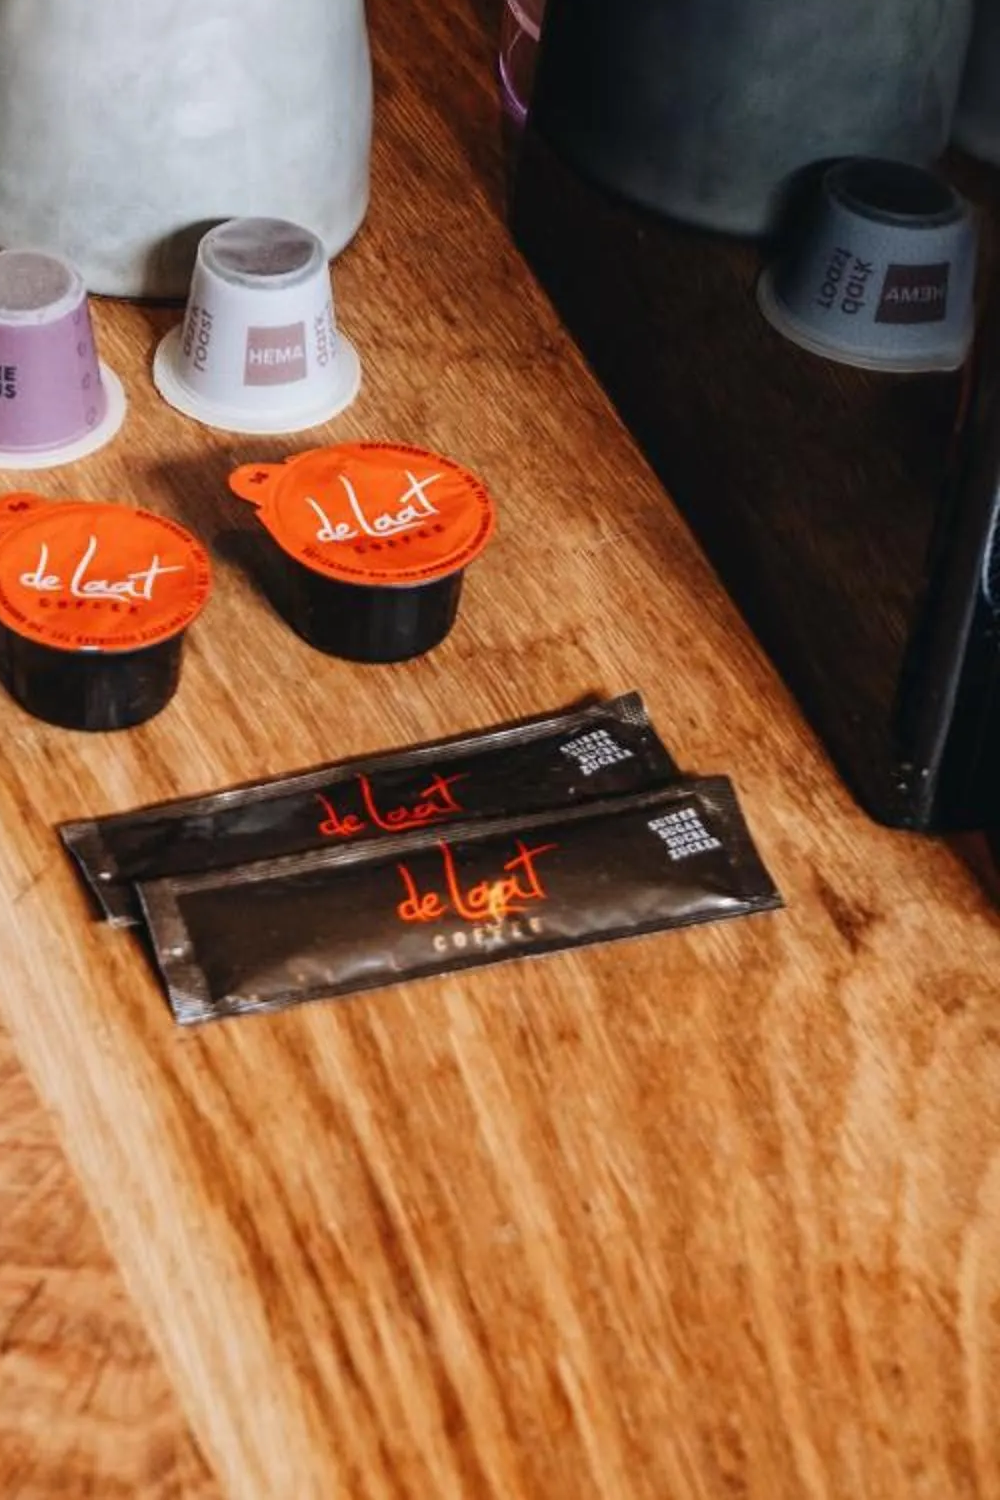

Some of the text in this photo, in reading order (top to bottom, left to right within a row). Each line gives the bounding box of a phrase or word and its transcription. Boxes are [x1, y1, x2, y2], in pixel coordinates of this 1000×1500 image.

[250, 346, 304, 366] HEMA
[305, 497, 359, 542] de
[19, 542, 62, 591] de
[315, 793, 366, 835] de
[397, 864, 447, 921] de
